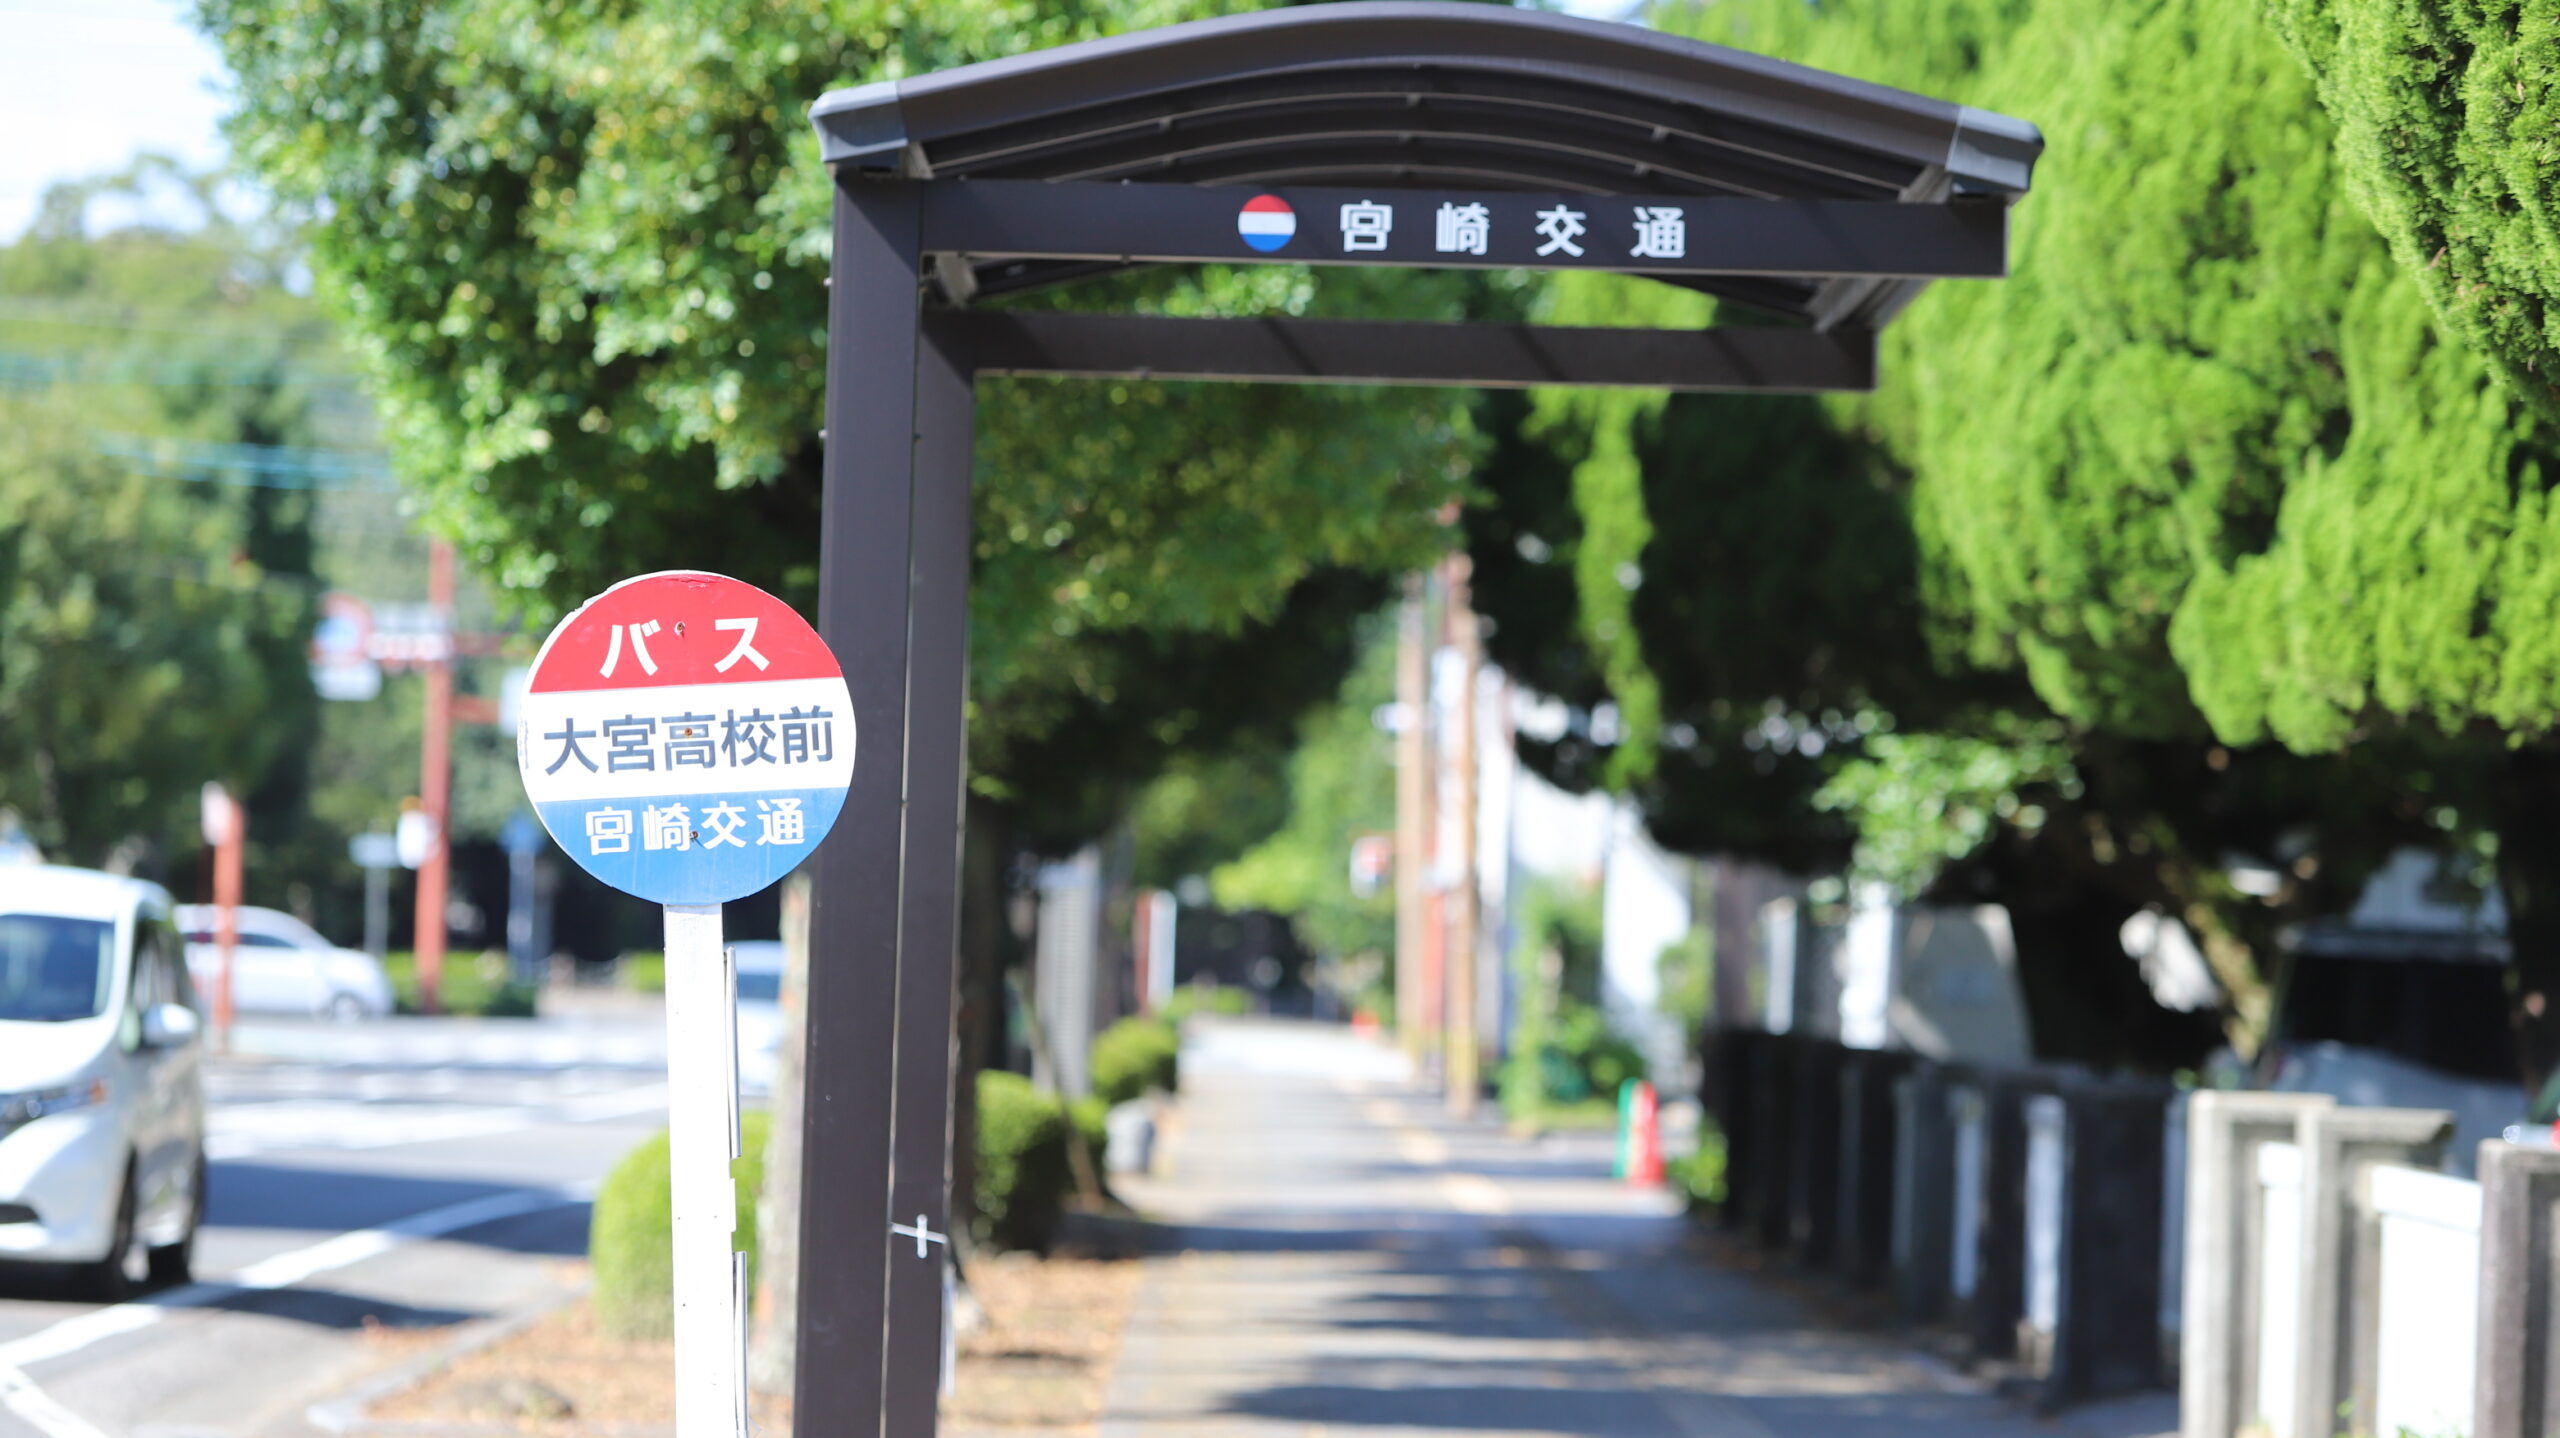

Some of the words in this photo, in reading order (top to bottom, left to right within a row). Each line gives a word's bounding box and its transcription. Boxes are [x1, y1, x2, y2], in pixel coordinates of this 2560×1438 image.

[1340, 200, 1686, 259] 宮崎交通
[599, 617, 771, 679] バス
[544, 705, 834, 776] 大宮高校前
[585, 798, 805, 855] 宮崎交通
